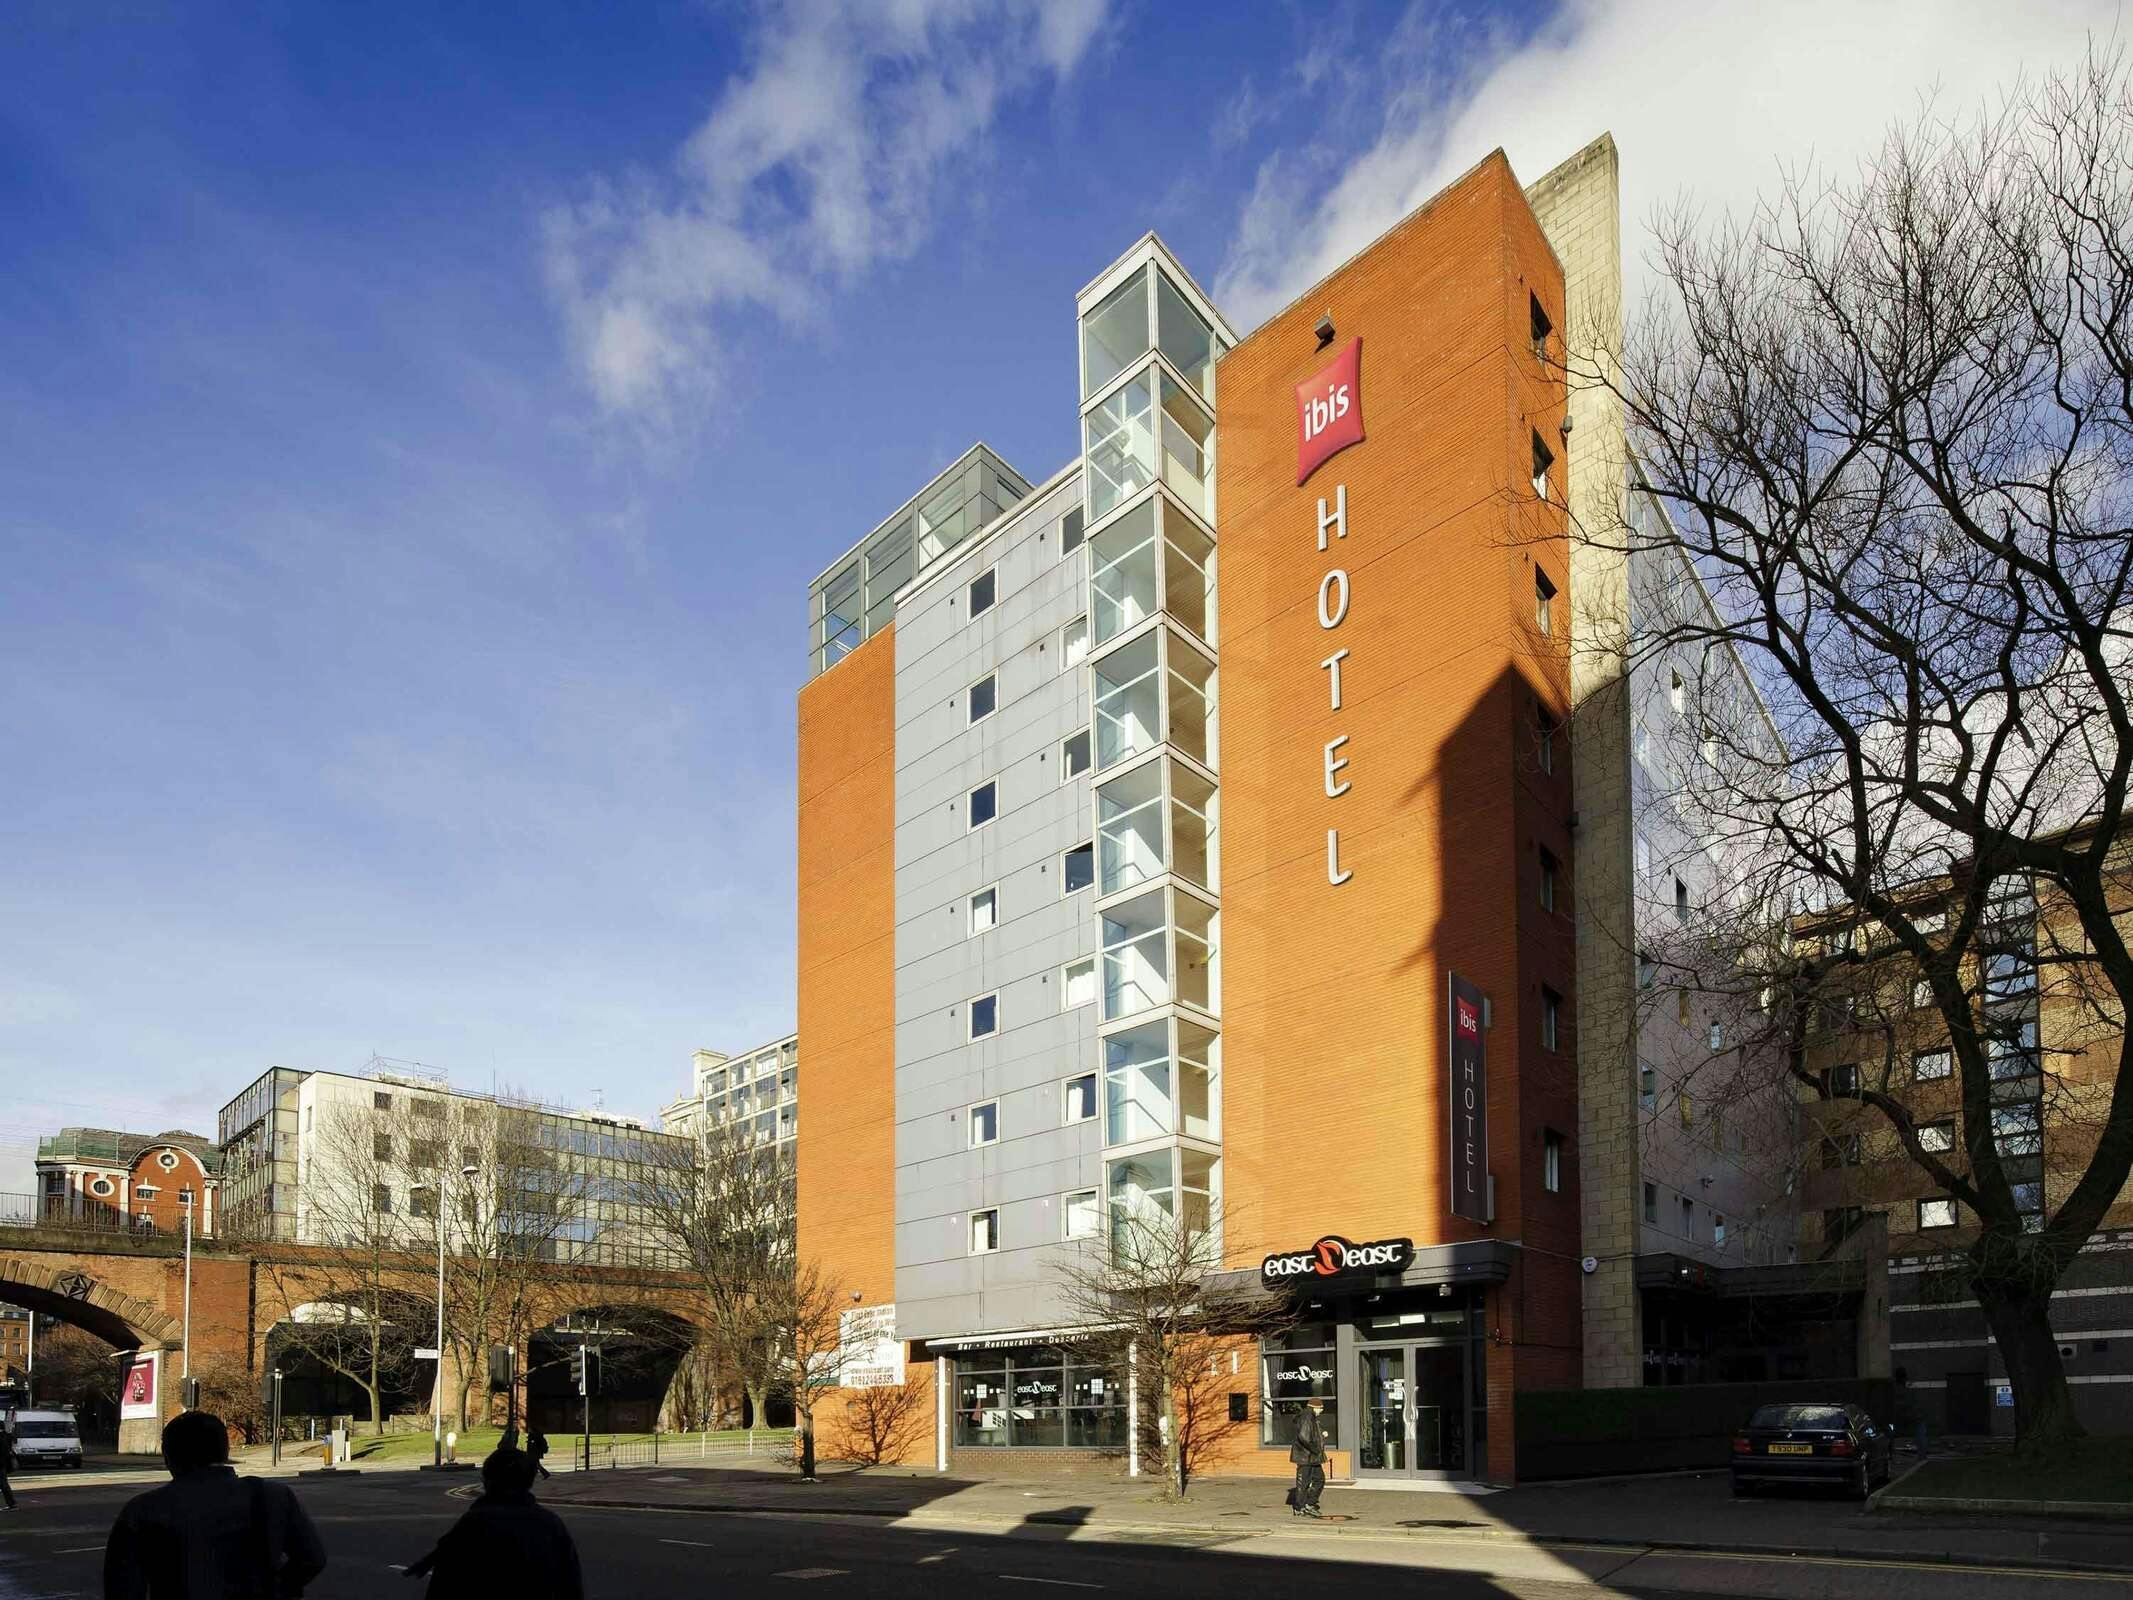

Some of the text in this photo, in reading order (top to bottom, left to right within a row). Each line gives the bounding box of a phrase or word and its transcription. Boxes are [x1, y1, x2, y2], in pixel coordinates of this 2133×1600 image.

[1304, 383, 1349, 442] ibis
[1317, 484, 1353, 886] HOTEL
[1460, 1008, 1477, 1033] ibis
[1464, 1058, 1475, 1193] HOTEL
[984, 1339, 1033, 1348] Restaurant
